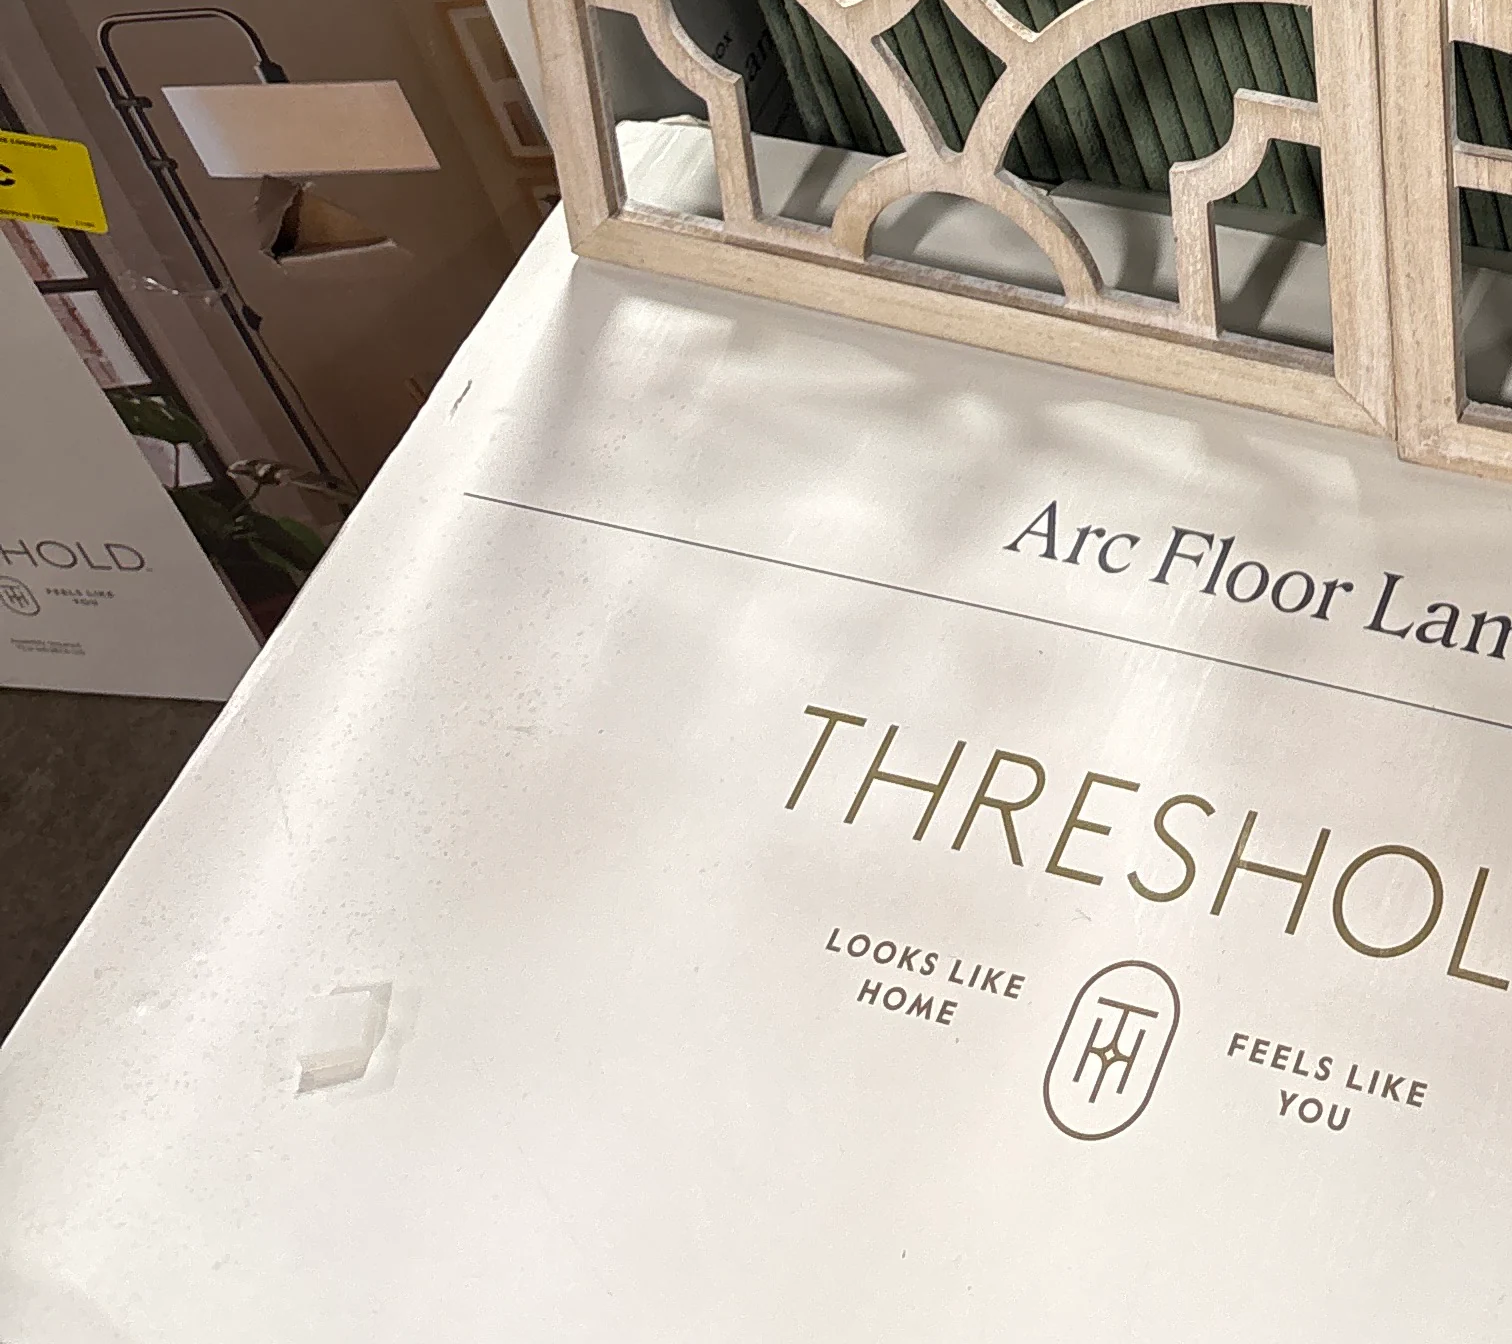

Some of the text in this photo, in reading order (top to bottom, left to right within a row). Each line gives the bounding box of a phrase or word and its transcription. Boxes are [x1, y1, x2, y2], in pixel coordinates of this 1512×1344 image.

[1004, 499, 1141, 575] Arc
[1149, 525, 1354, 621] Floor
[825, 927, 1026, 1000] LOOKS LIKE
[856, 978, 959, 1026] HOME
[1227, 1032, 1429, 1108] FEELS LIKE
[1279, 1089, 1352, 1132] YOU
